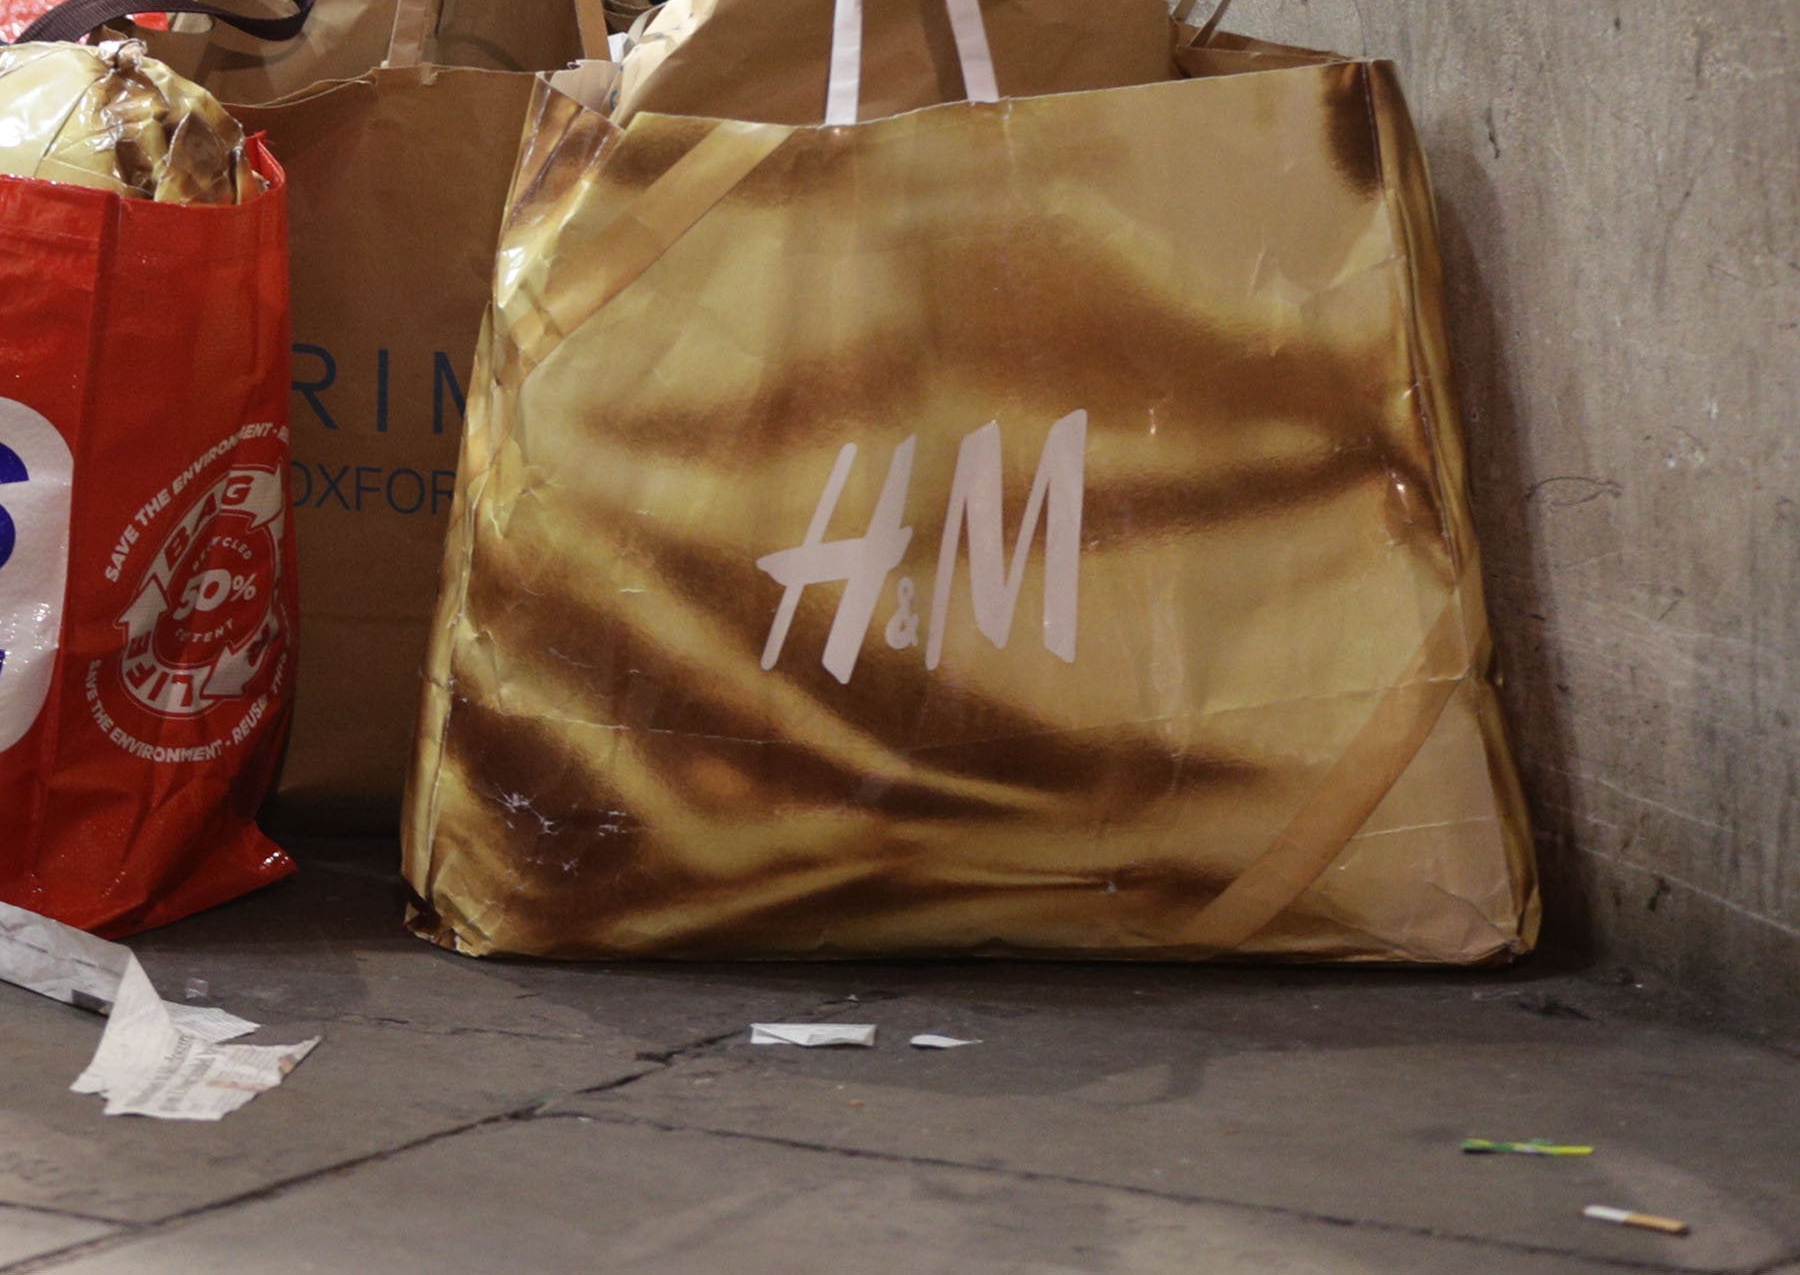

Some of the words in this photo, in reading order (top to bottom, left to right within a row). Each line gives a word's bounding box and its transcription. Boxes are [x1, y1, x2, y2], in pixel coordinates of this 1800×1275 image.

[104, 524, 140, 583] SAVE
[134, 488, 172, 526] THE
[755, 408, 1088, 686] H&M
[172, 567, 257, 621] 50%
[90, 700, 114, 733] THE
[109, 726, 223, 763] ENVIRONMENT
